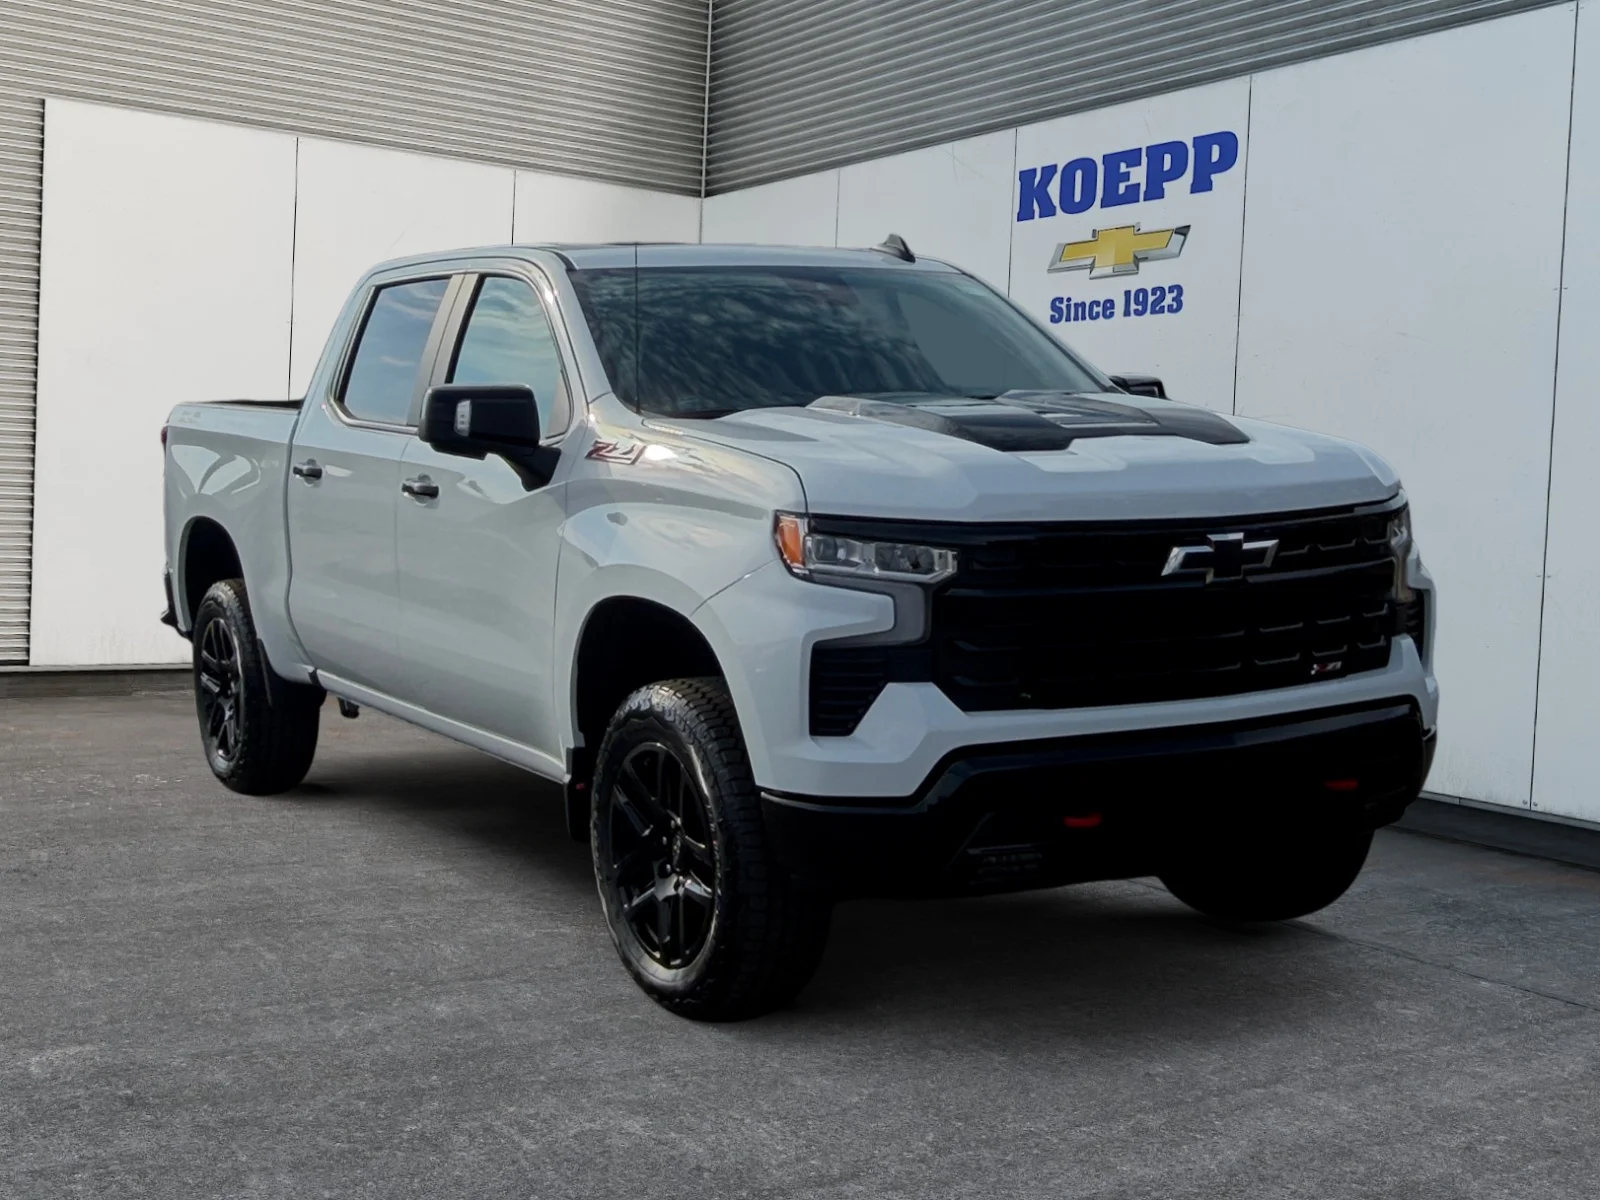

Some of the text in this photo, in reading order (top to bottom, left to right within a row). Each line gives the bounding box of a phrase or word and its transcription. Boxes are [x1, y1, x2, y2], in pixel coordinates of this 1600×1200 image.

[1016, 131, 1239, 222] KOEPP
[1050, 284, 1184, 324] Since 1923
